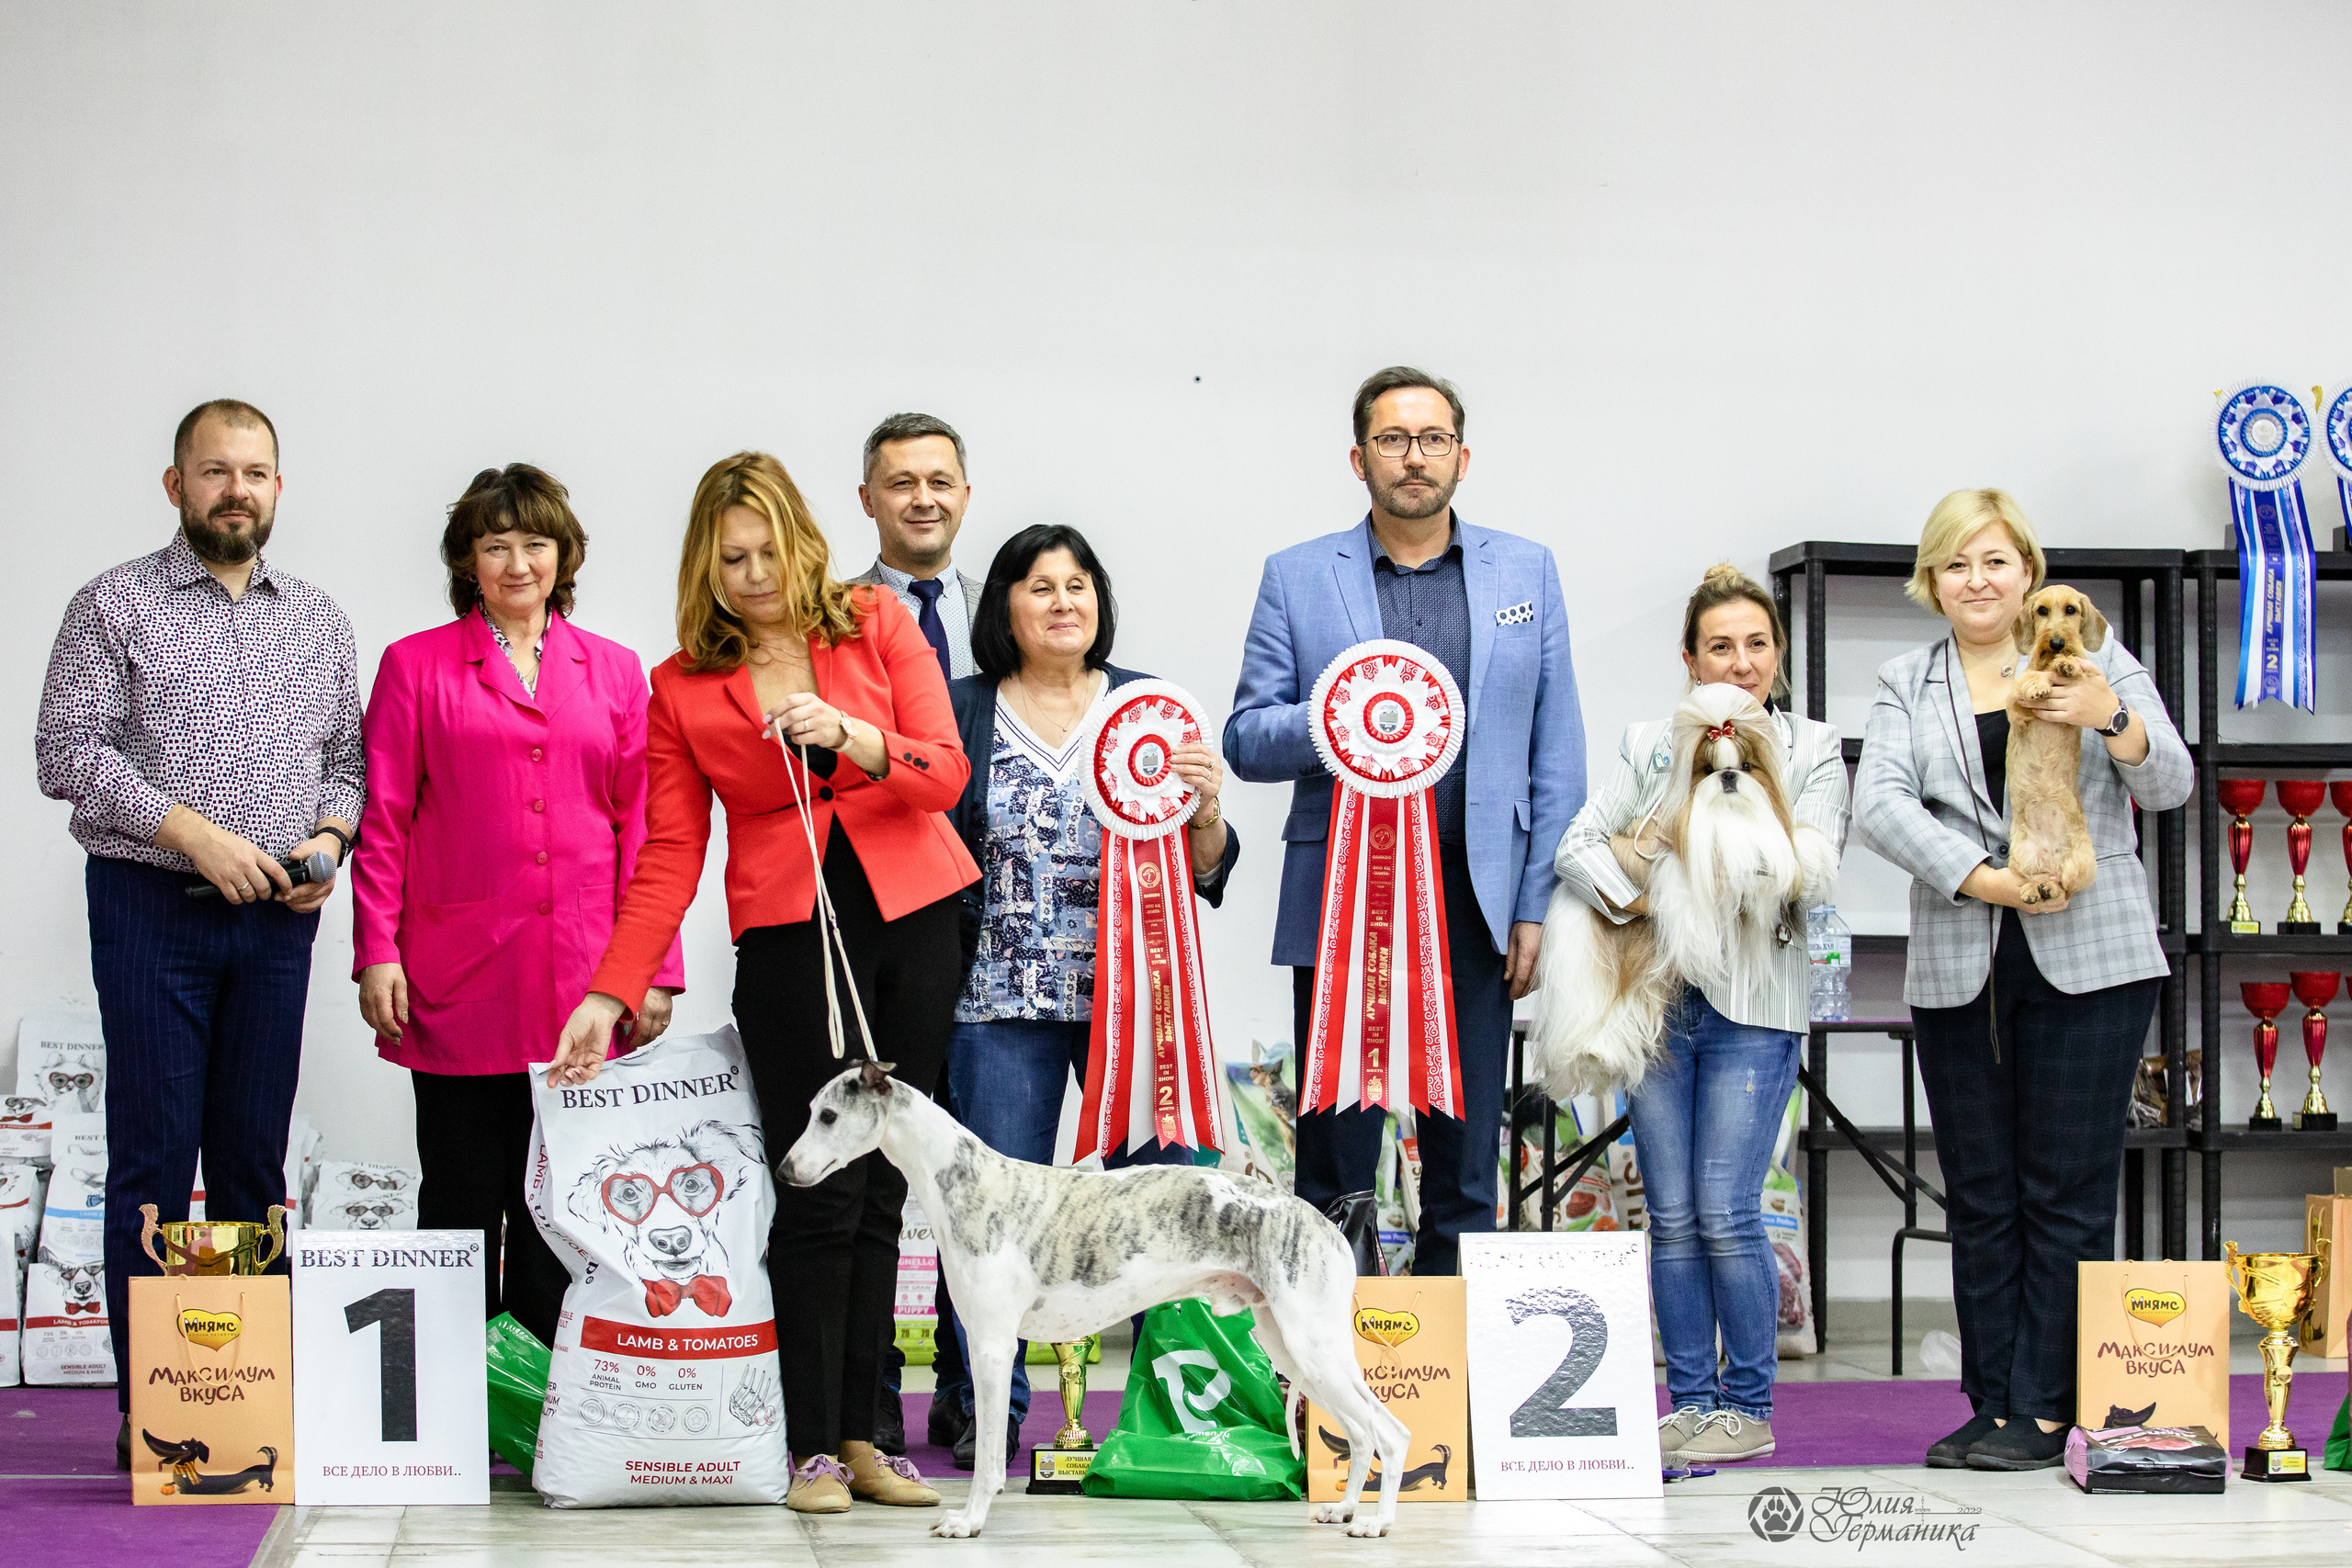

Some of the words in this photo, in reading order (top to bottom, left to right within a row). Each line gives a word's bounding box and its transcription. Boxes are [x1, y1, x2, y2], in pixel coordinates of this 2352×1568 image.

[2267, 654, 2278, 669] 2
[1368, 931, 1378, 974] СОБАКА
[1378, 946, 1389, 1005] ВЫСТАВКИ
[1152, 970, 1162, 1011] СОБАКА
[1366, 975, 1376, 1020] ЛУЧШАЯ
[1162, 985, 1173, 1042] ВЫСТАВКИ
[1155, 1014, 1165, 1058] ЛУЧШАЯ
[40, 1041, 63, 1050] BEST
[1368, 1048, 1379, 1067] 1
[560, 1088, 624, 1108] BEST
[631, 1072, 738, 1104] DINNER
[1159, 1086, 1173, 1106] 2
[300, 1249, 365, 1267] BEST
[371, 1249, 473, 1267] DINNER
[617, 1334, 663, 1350] LAMB
[667, 1339, 679, 1350] &
[683, 1334, 758, 1351] TOMATOES
[344, 1288, 417, 1441] 1
[594, 1359, 620, 1373] 73%
[637, 1365, 656, 1377] 0%
[1505, 1286, 1618, 1438] 2
[2126, 1359, 2186, 1378] ВКУСА
[592, 1373, 620, 1383] ANIMAL
[678, 1368, 696, 1378] 0%
[1363, 1365, 1451, 1382] КСИМУМ
[589, 1380, 621, 1391] PROTEIN
[635, 1381, 657, 1389] GMO
[1369, 1382, 1419, 1403] КУСА
[180, 1384, 244, 1405] ВКУСА
[322, 1466, 347, 1476] ВСЕ
[351, 1466, 388, 1478] ДЕЛО
[391, 1466, 400, 1476] В
[626, 1461, 693, 1472] SENSIBLE
[695, 1461, 741, 1472] ADULT
[1501, 1461, 1525, 1472] ВСЕ
[1528, 1461, 1564, 1472] ДЕЛО
[1567, 1460, 1576, 1471] В
[630, 1474, 686, 1484] MEDIUM
[689, 1476, 697, 1484] &
[701, 1475, 733, 1484] MAXI
